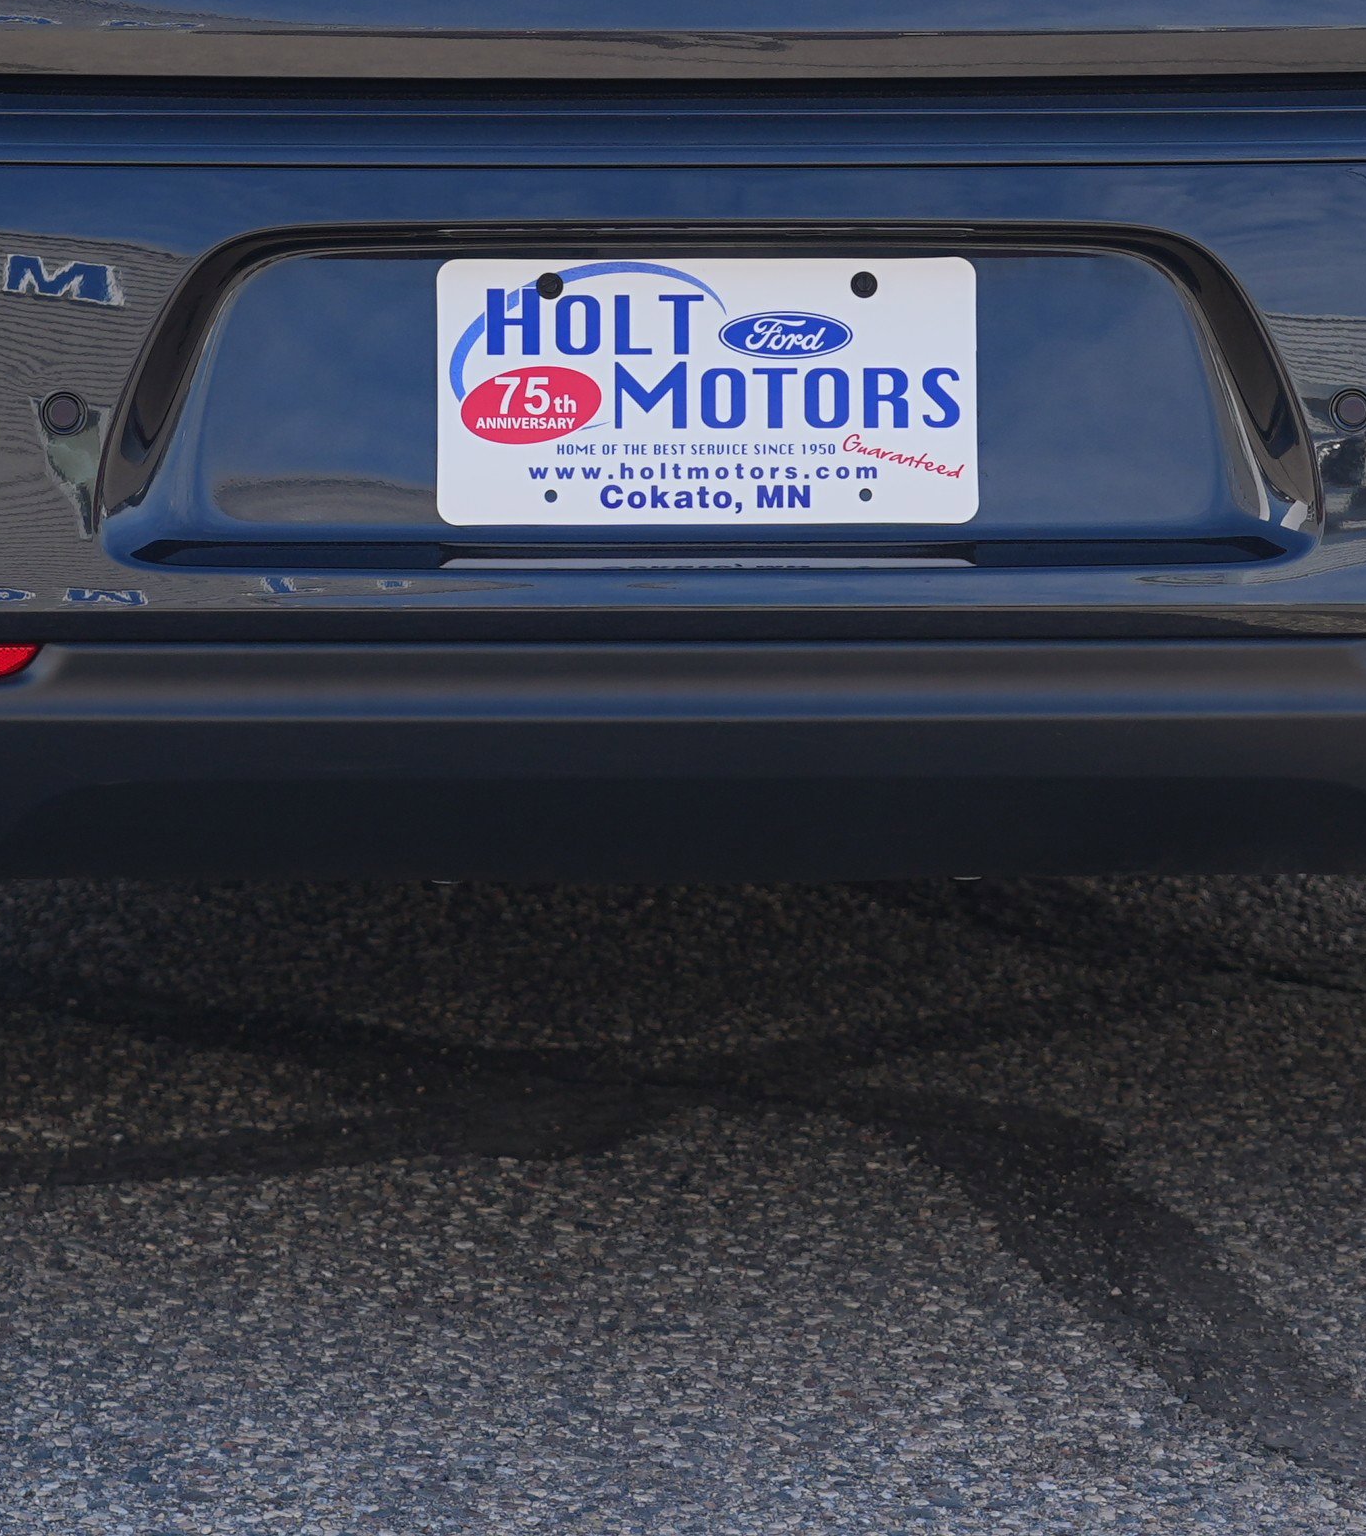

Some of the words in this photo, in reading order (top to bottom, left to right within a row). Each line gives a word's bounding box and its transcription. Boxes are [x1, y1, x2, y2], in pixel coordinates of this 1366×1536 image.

[486, 287, 705, 356] HOLT
[744, 318, 827, 353] Ford
[493, 375, 578, 416] 75th
[613, 360, 962, 430] MOTORS
[475, 416, 577, 431] ANNIVERSARY
[556, 443, 597, 456] HOME
[601, 443, 618, 456] OF
[623, 443, 648, 456] THE
[653, 443, 686, 456] BEST
[690, 443, 749, 456] SERVICE
[753, 443, 795, 456] SINCE
[801, 443, 836, 456] 1950
[841, 432, 966, 480] Guaranteed
[527, 462, 879, 481] www.holtmotors.com
[599, 484, 744, 514] Cokato,
[755, 484, 812, 509] MN
